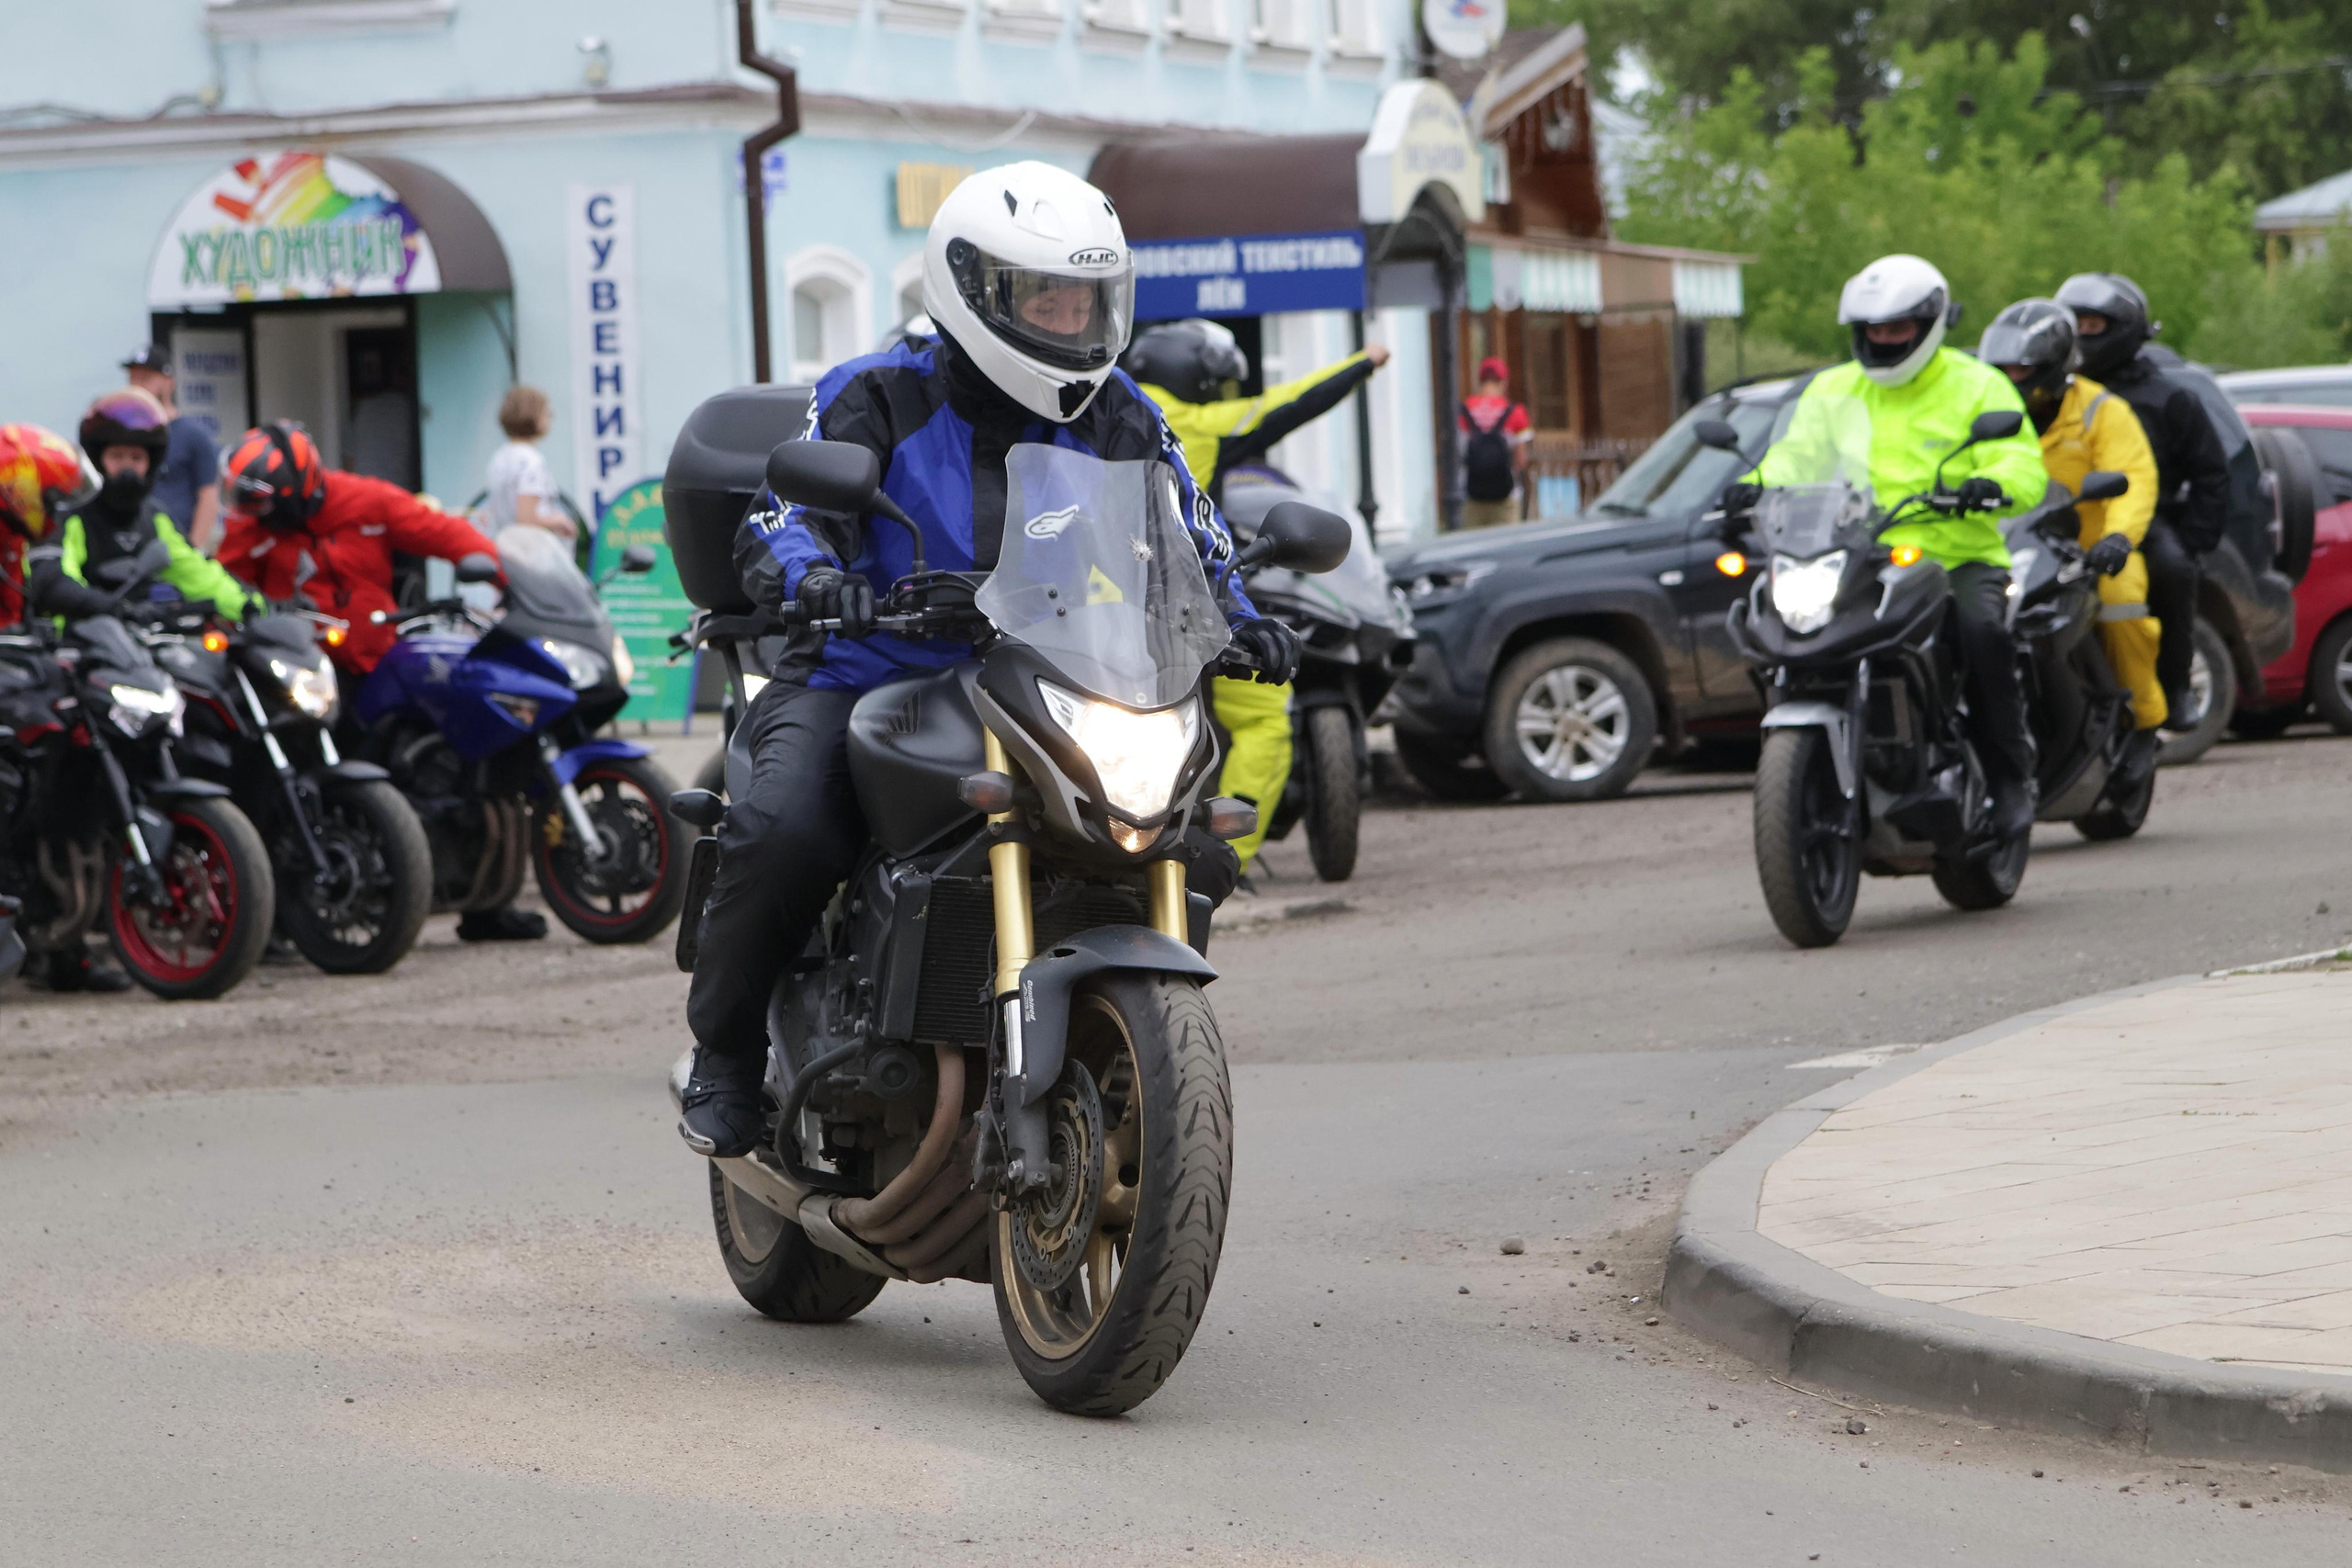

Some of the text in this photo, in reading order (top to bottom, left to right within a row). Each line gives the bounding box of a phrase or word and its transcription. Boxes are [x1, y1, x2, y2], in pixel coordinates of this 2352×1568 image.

[178, 217, 406, 288] ХУДОЖНИК
[1078, 253, 1114, 265] HJC
[1240, 236, 1363, 274] ТЕКСТИЛЬ
[1026, 979, 1036, 1021] Combined
